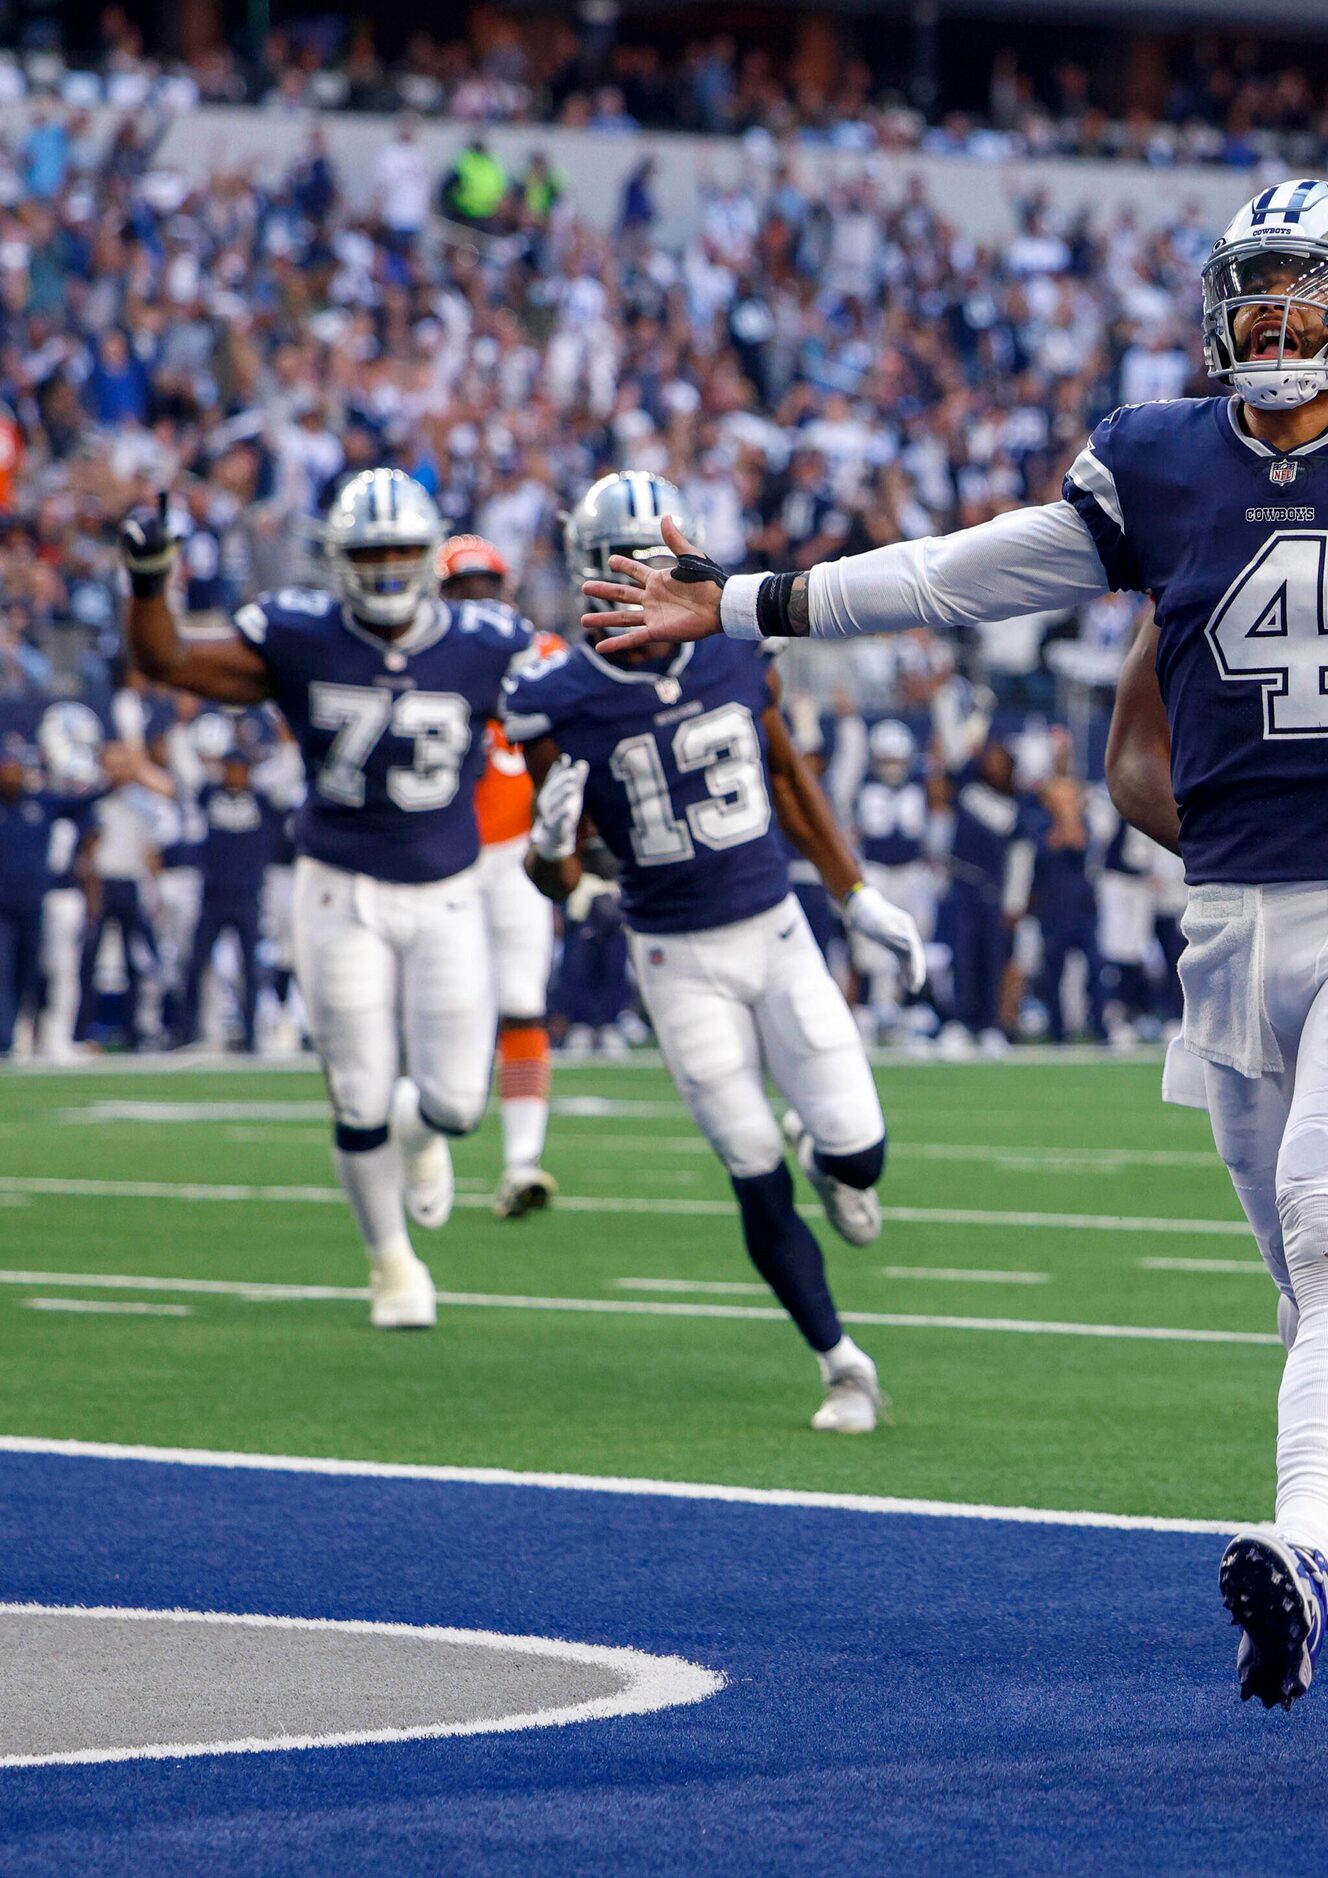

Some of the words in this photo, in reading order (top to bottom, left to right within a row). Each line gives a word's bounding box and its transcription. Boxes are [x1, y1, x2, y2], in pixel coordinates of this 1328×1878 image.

[1252, 227, 1292, 237] COWBOYS
[1273, 469, 1293, 481] NFL
[1245, 507, 1315, 522] COWBOYS
[308, 680, 472, 812] 73
[609, 701, 771, 867] 13
